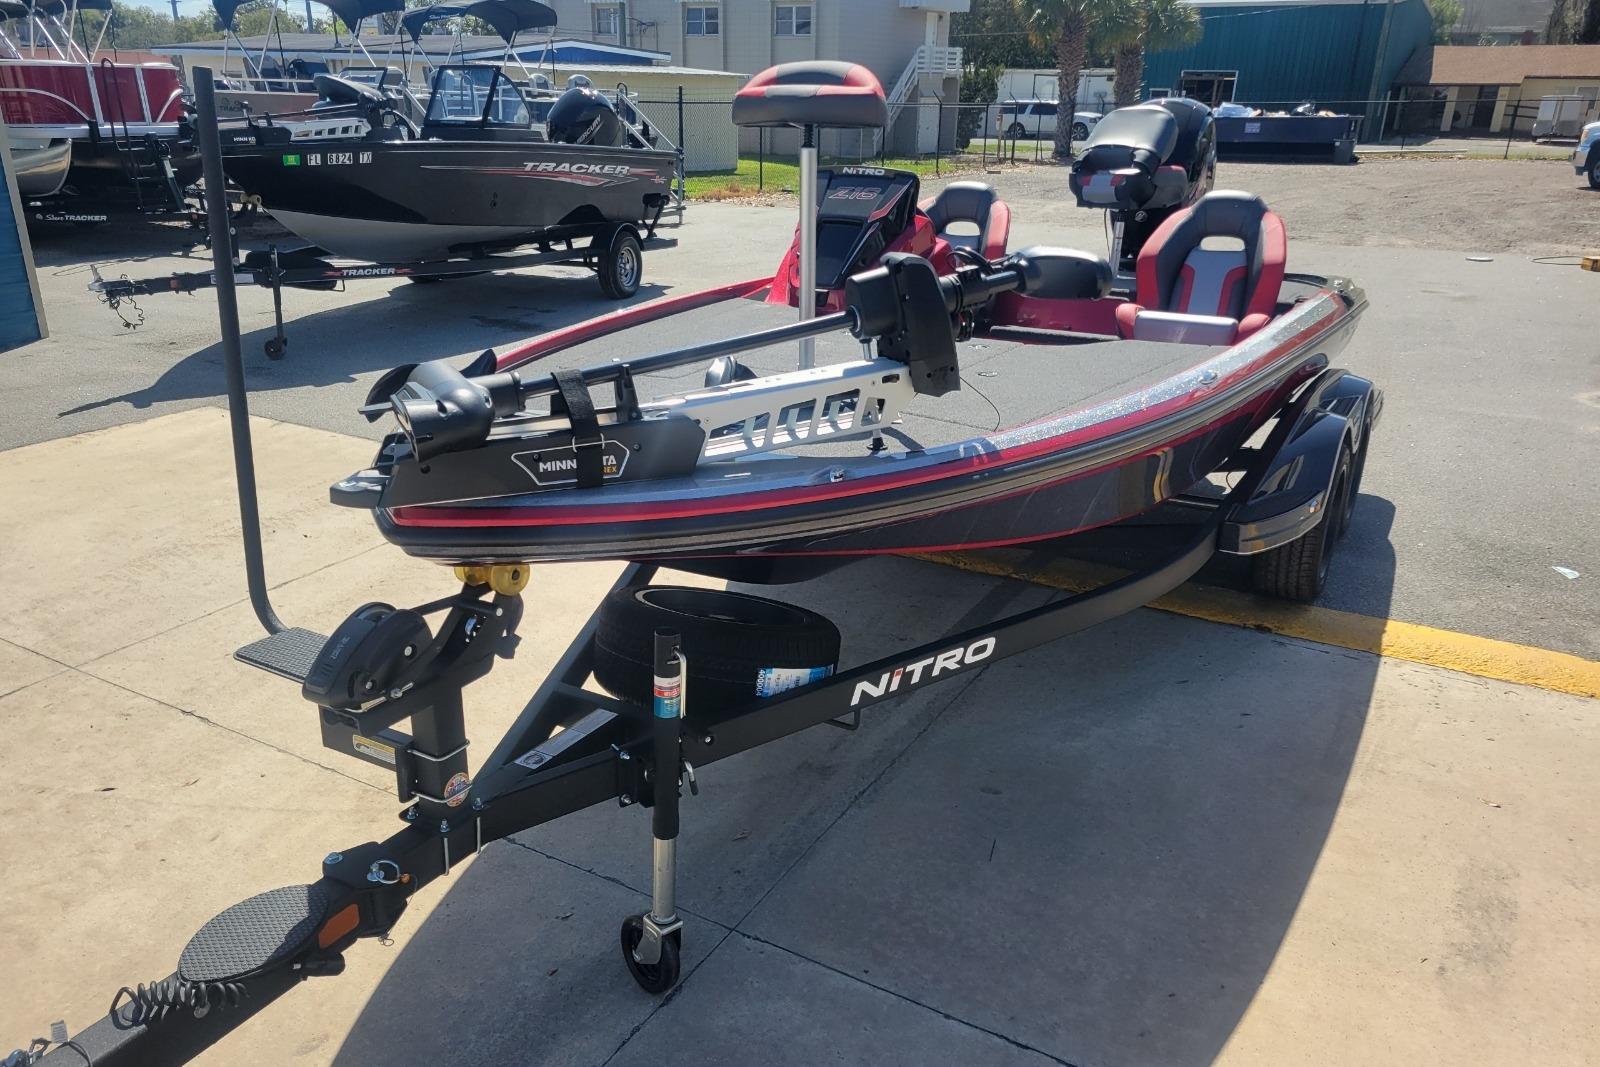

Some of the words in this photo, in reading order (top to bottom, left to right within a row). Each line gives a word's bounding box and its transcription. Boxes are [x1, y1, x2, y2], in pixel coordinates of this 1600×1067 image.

[308, 154, 321, 165] FL
[360, 152, 372, 164] TX
[523, 162, 630, 175] TRACKER
[341, 268, 395, 276] TRACKER
[539, 459, 578, 473] MINN
